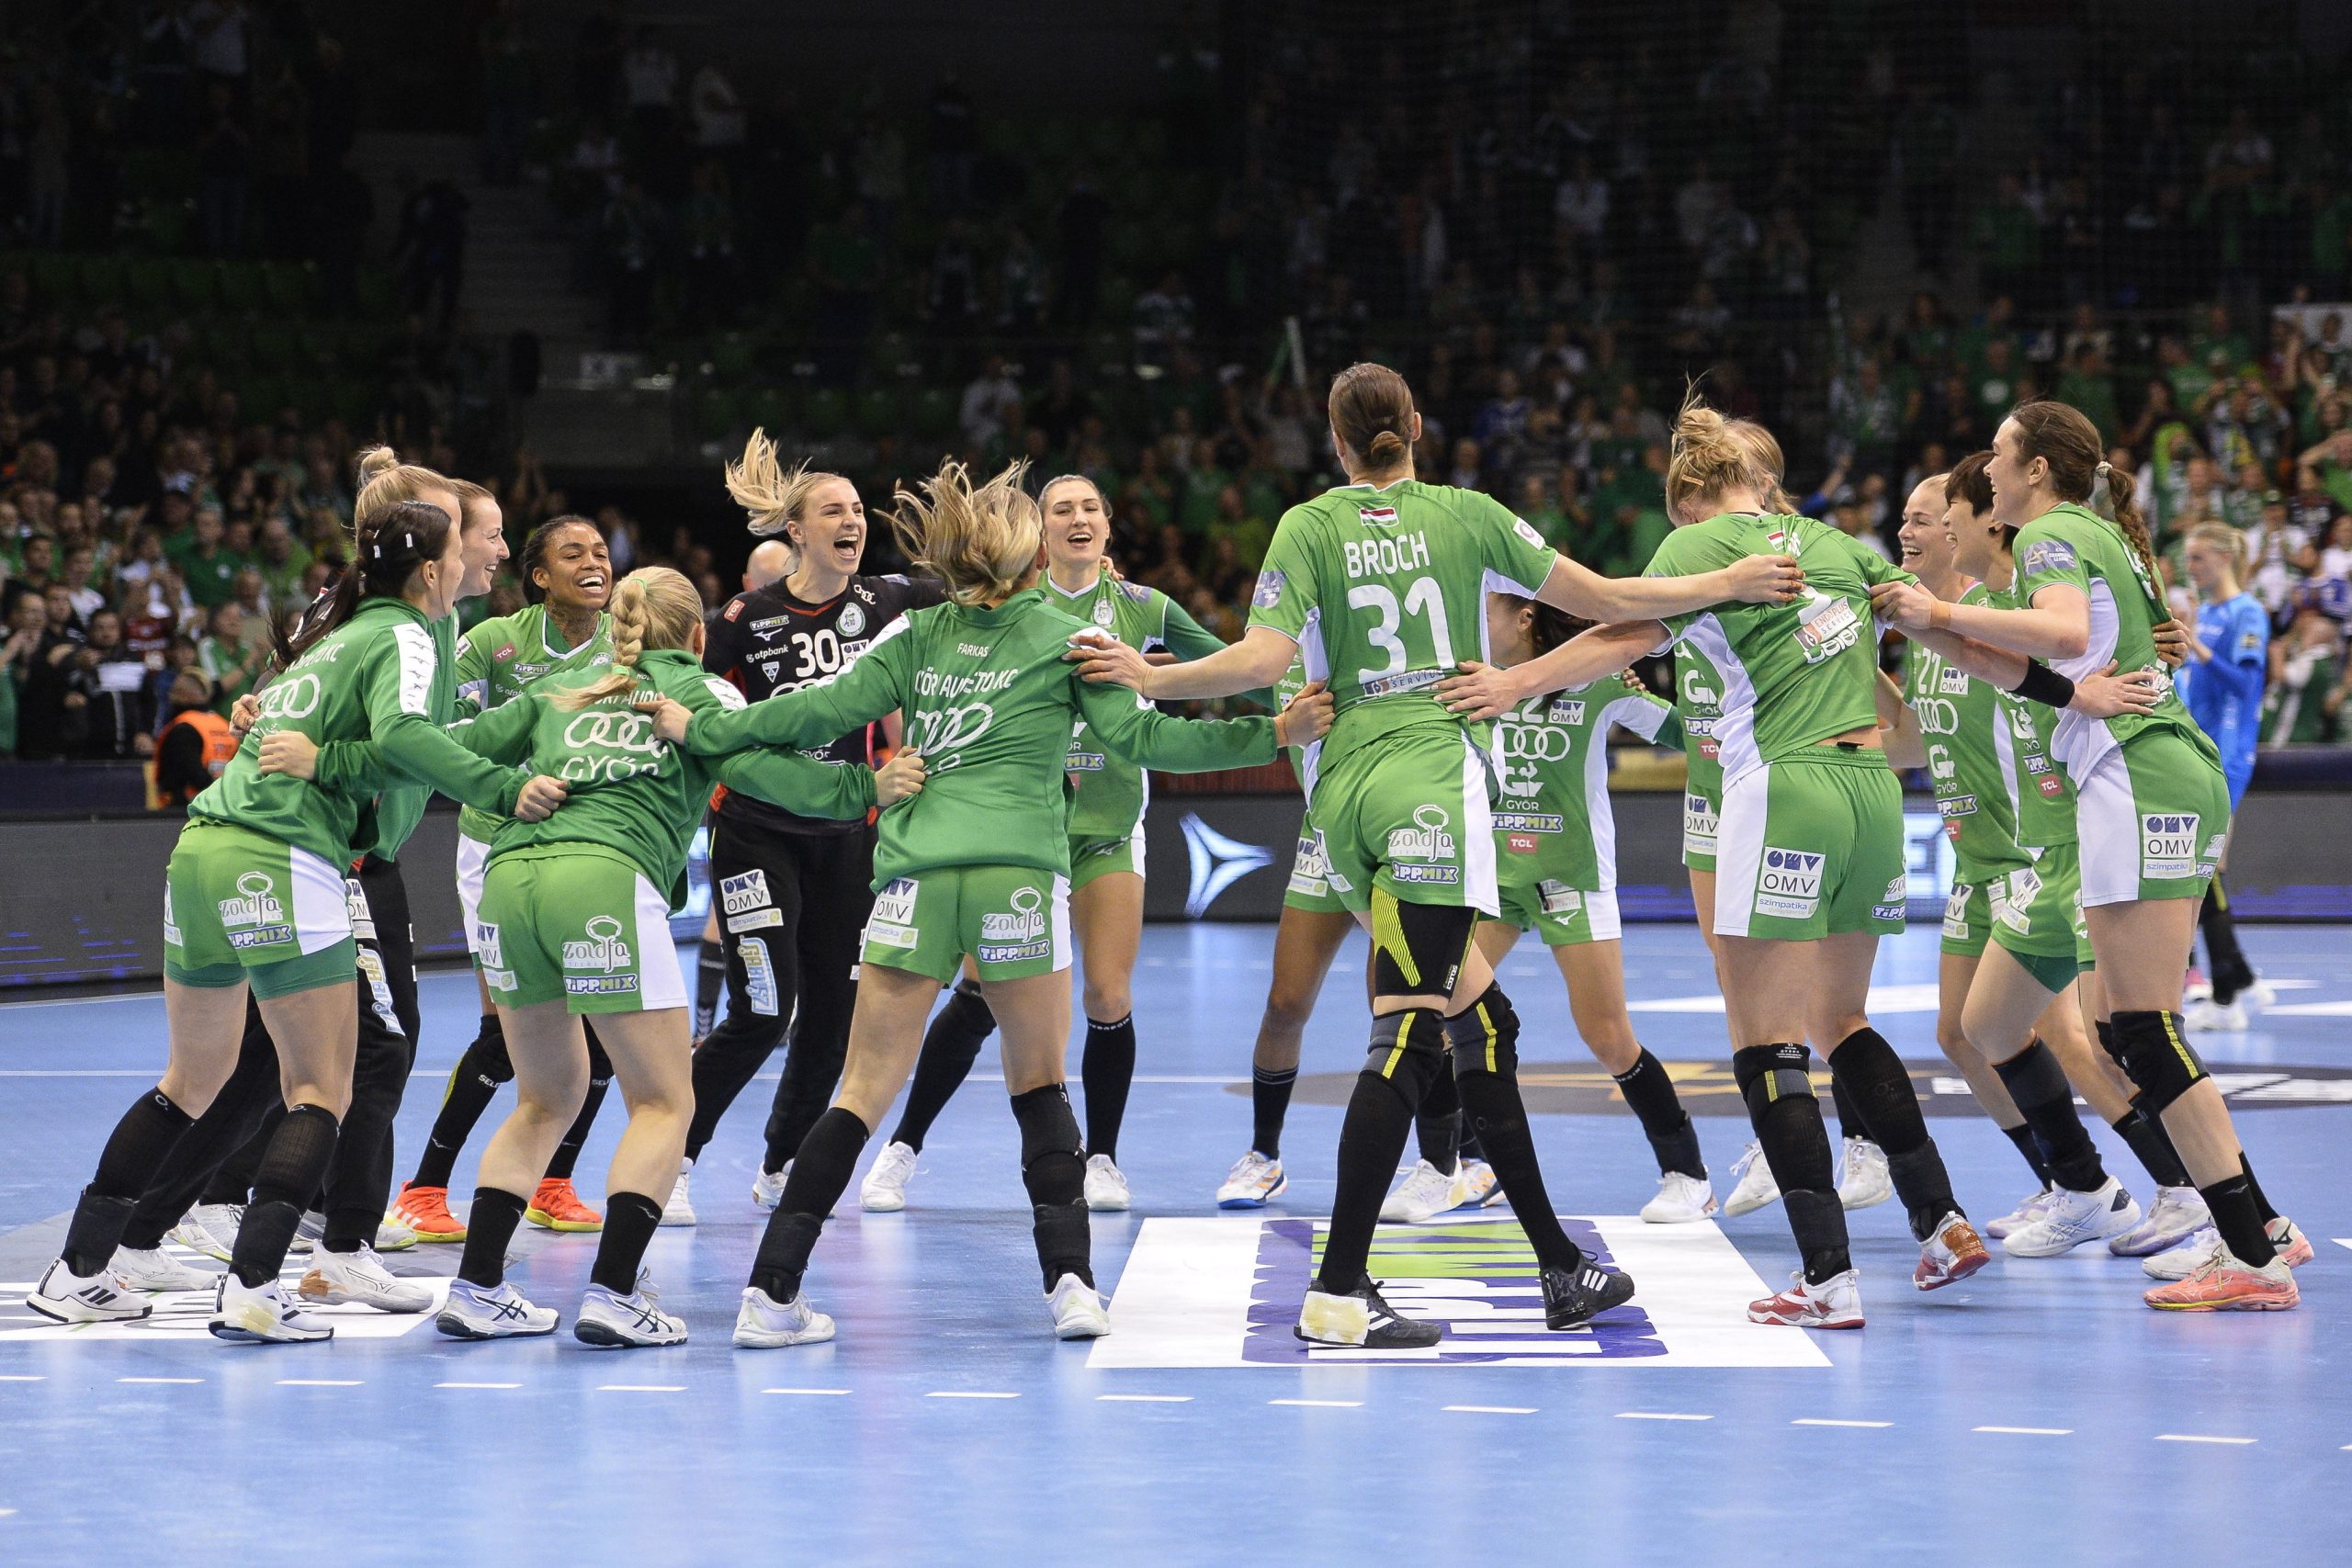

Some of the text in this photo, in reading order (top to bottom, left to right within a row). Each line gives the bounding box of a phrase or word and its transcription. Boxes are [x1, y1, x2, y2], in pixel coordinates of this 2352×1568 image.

[1344, 530, 1430, 579] BROCH
[728, 604, 741, 617] TCL
[1347, 577, 1455, 685] 31
[497, 647, 514, 660] TCL
[754, 644, 789, 660] otpbank
[791, 628, 841, 678] 30
[956, 642, 989, 658] FARKAS
[1940, 682, 1966, 693] OMV
[1551, 713, 1580, 724] OMV
[2041, 780, 2058, 792] TCL
[1686, 816, 1718, 833] OMV
[1947, 826, 1958, 836] CL
[1510, 838, 1533, 849] TCL
[2147, 839, 2193, 855] OMV
[1763, 873, 1816, 894] OMV
[727, 890, 764, 912] OMV
[1758, 898, 1808, 911] szimpatika
[876, 900, 910, 920] OMV
